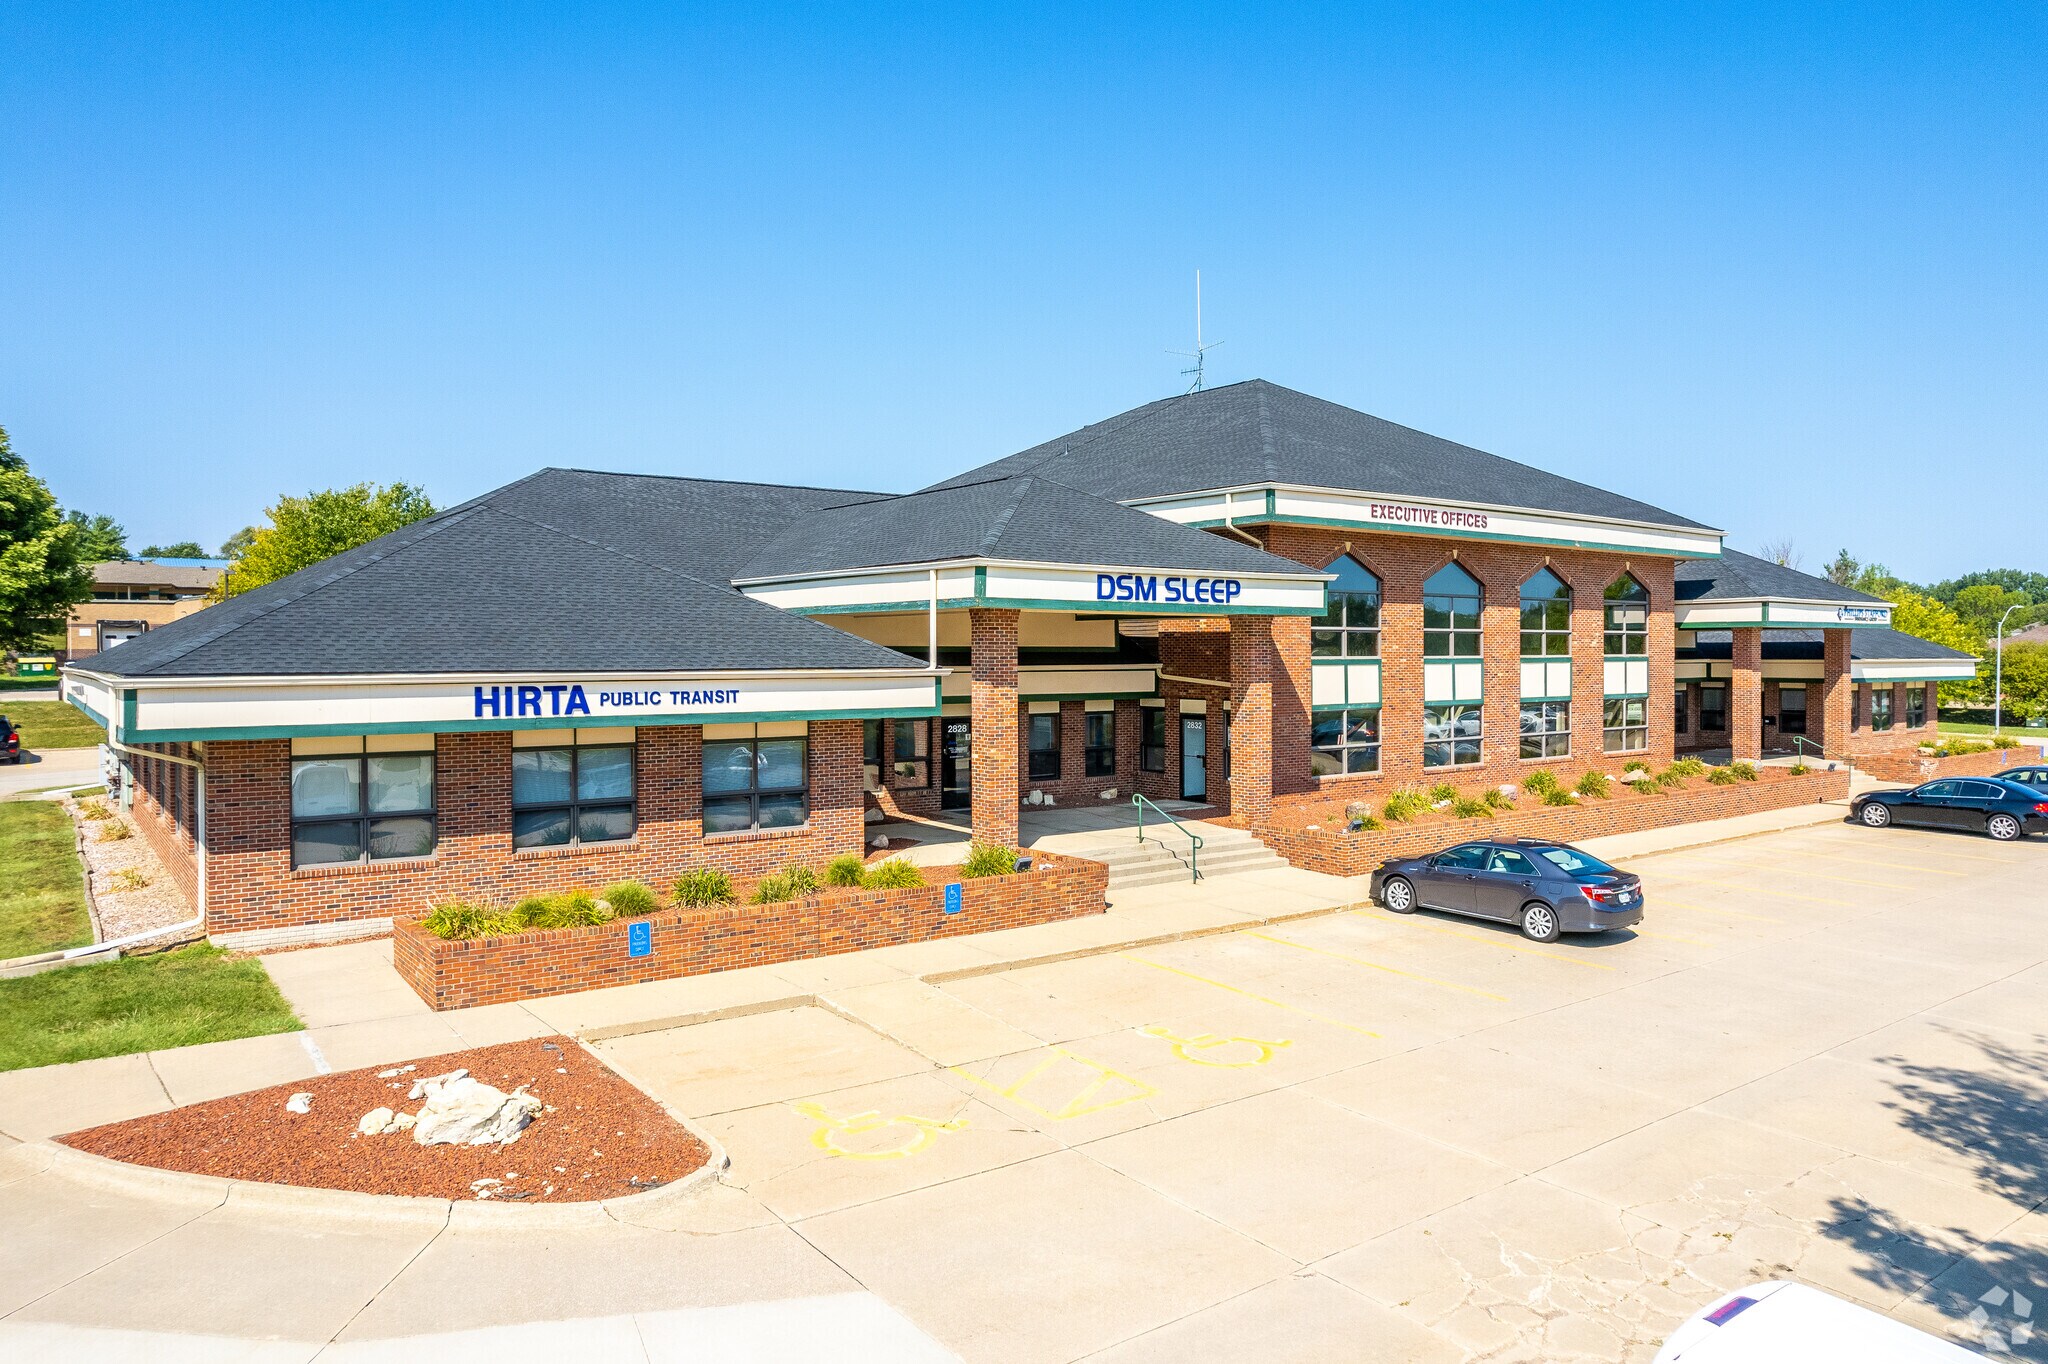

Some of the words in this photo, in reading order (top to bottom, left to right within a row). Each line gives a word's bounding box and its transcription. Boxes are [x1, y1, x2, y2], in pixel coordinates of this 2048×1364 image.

[1371, 504, 1438, 523] EXECUTIVE
[1441, 512, 1488, 528] OFFICES
[1097, 575, 1157, 601] DSM
[1165, 578, 1241, 604] SLEEP
[475, 686, 590, 717] HIRTA
[601, 691, 660, 706] PUBLIC
[671, 690, 738, 704] TRANSIT
[948, 725, 967, 733] 2828
[1187, 721, 1202, 730] 2832
